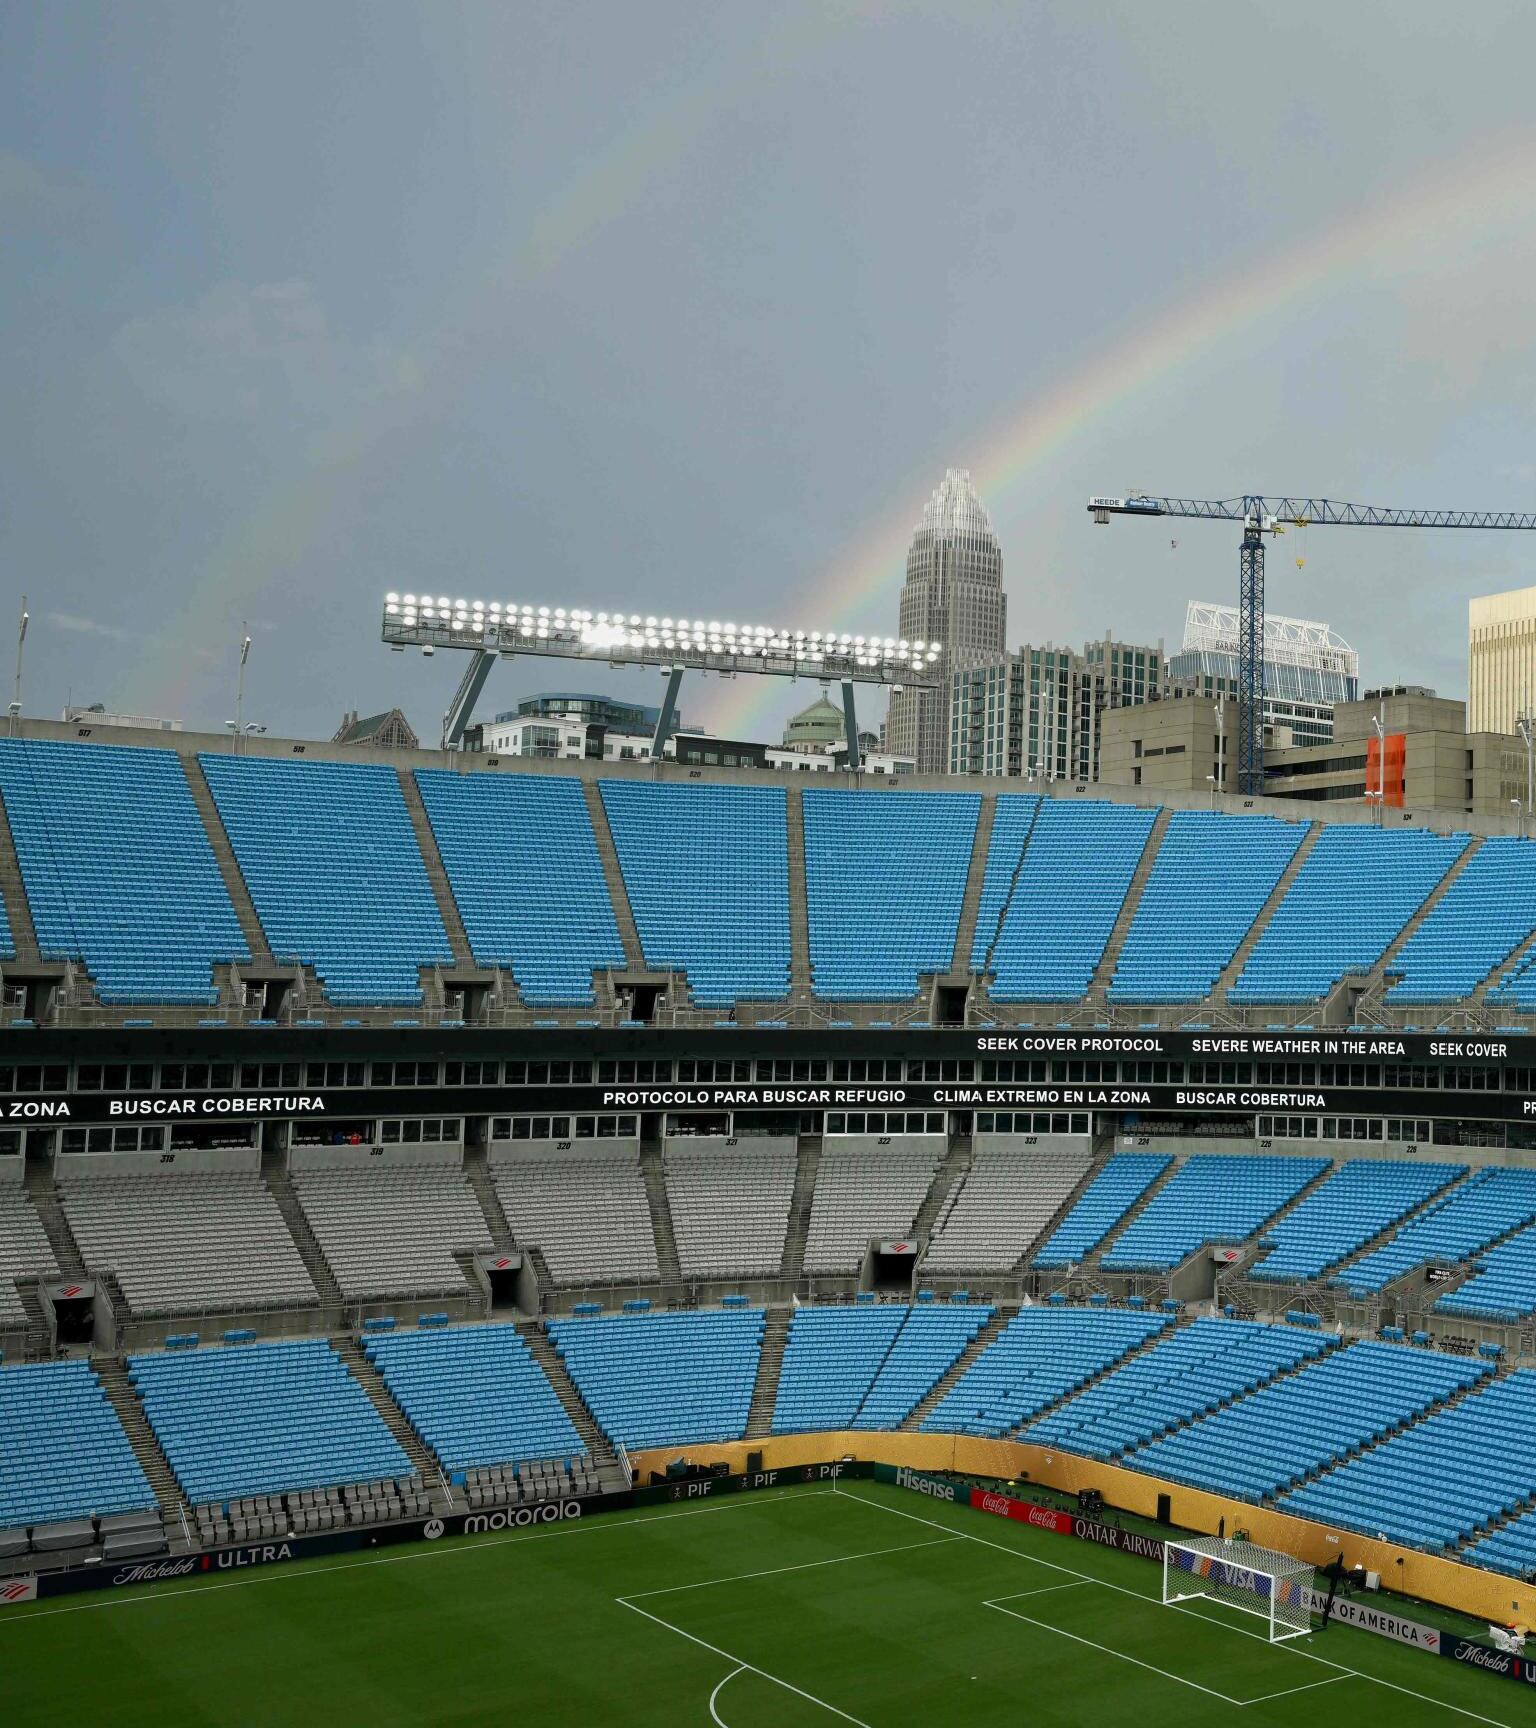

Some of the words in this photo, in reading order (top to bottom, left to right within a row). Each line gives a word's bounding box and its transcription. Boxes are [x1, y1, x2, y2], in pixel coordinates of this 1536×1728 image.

[78, 729, 92, 737] 517
[977, 1037, 1019, 1050] SEEK
[1022, 1038, 1077, 1051] COVER
[1081, 1038, 1164, 1052] PROTOCOL
[1191, 1039, 1249, 1052] SEVERE
[1252, 1040, 1321, 1053] WEATHER
[1324, 1040, 1338, 1054] IN
[1341, 1041, 1367, 1054] THE
[1368, 1041, 1406, 1055] AREA
[1429, 1042, 1464, 1056] SEEK
[1466, 1043, 1507, 1057] COVER
[603, 1091, 709, 1105] PROTOCOLO
[714, 1090, 759, 1103] PARA
[762, 1090, 831, 1103] BUSCAR
[835, 1090, 906, 1102] REFUGIO
[933, 1090, 983, 1102] CLIMA
[986, 1090, 1060, 1103] EXTREMO
[1063, 1090, 1084, 1103] EN
[1088, 1091, 1108, 1103] LA
[1110, 1091, 1151, 1104] ZONA
[1176, 1092, 1237, 1105] BUSCAR
[1240, 1092, 1326, 1107] COBERTURA
[9, 1102, 71, 1117] ZONA
[109, 1099, 196, 1115] BUSCAR
[202, 1096, 325, 1113] COBERTURA
[557, 1142, 571, 1150] 320
[726, 1138, 738, 1146] 321
[878, 1137, 891, 1145] 322
[1025, 1137, 1037, 1145] 323
[1137, 1138, 1150, 1146] 224
[1260, 1140, 1272, 1148] 225
[160, 1154, 175, 1163] 318
[370, 1147, 384, 1156] 319
[820, 1464, 844, 1478] PIF
[754, 1472, 778, 1487] PIF
[896, 1467, 955, 1500] Hisense
[688, 1481, 712, 1497] PIF
[982, 1494, 1011, 1516] Coca-Cola
[464, 1500, 581, 1534] motorola
[1028, 1507, 1057, 1529] Coca-Cola
[1075, 1519, 1117, 1547] QATAR
[113, 1557, 198, 1585] Michelob
[218, 1543, 292, 1568] ULTRA
[1225, 1564, 1256, 1592] VISA
[1340, 1604, 1356, 1620] OF
[1358, 1611, 1419, 1642] AMERICA
[1454, 1641, 1509, 1673] Michelob
